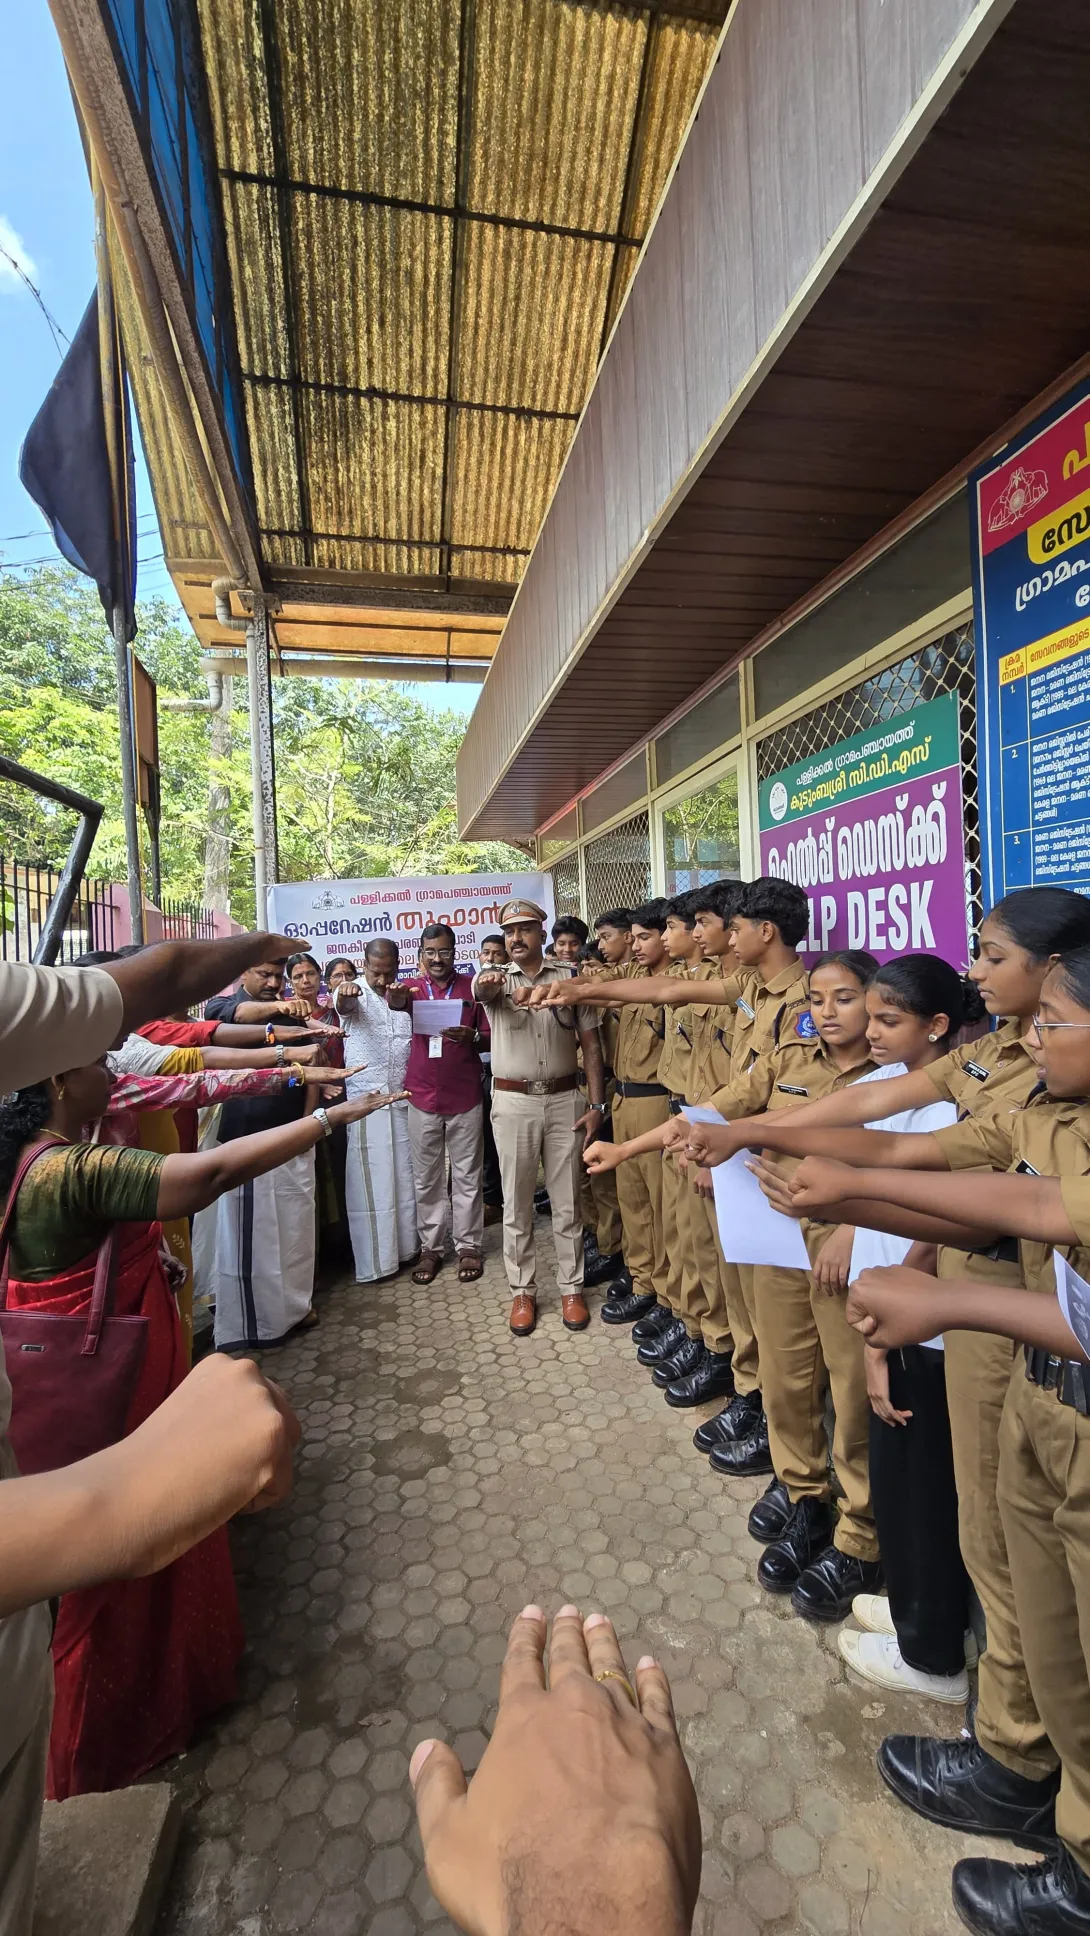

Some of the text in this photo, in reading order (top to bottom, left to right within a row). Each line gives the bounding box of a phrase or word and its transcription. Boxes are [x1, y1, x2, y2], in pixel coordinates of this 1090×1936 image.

[790, 735, 932, 811] കുടുംബശ്രീ സി.ഡി.എസ്
[797, 720, 915, 786] പള്ളിക്കൽ ഗ്രാമപഞ്ചായത്ത്
[284, 912, 393, 938] ഓപ്പറേഷൻ
[350, 883, 512, 905] പള്ളിക്കൽ ഗ്രാമപഞ്ചായത്ത്
[796, 880, 936, 952] LP DESK
